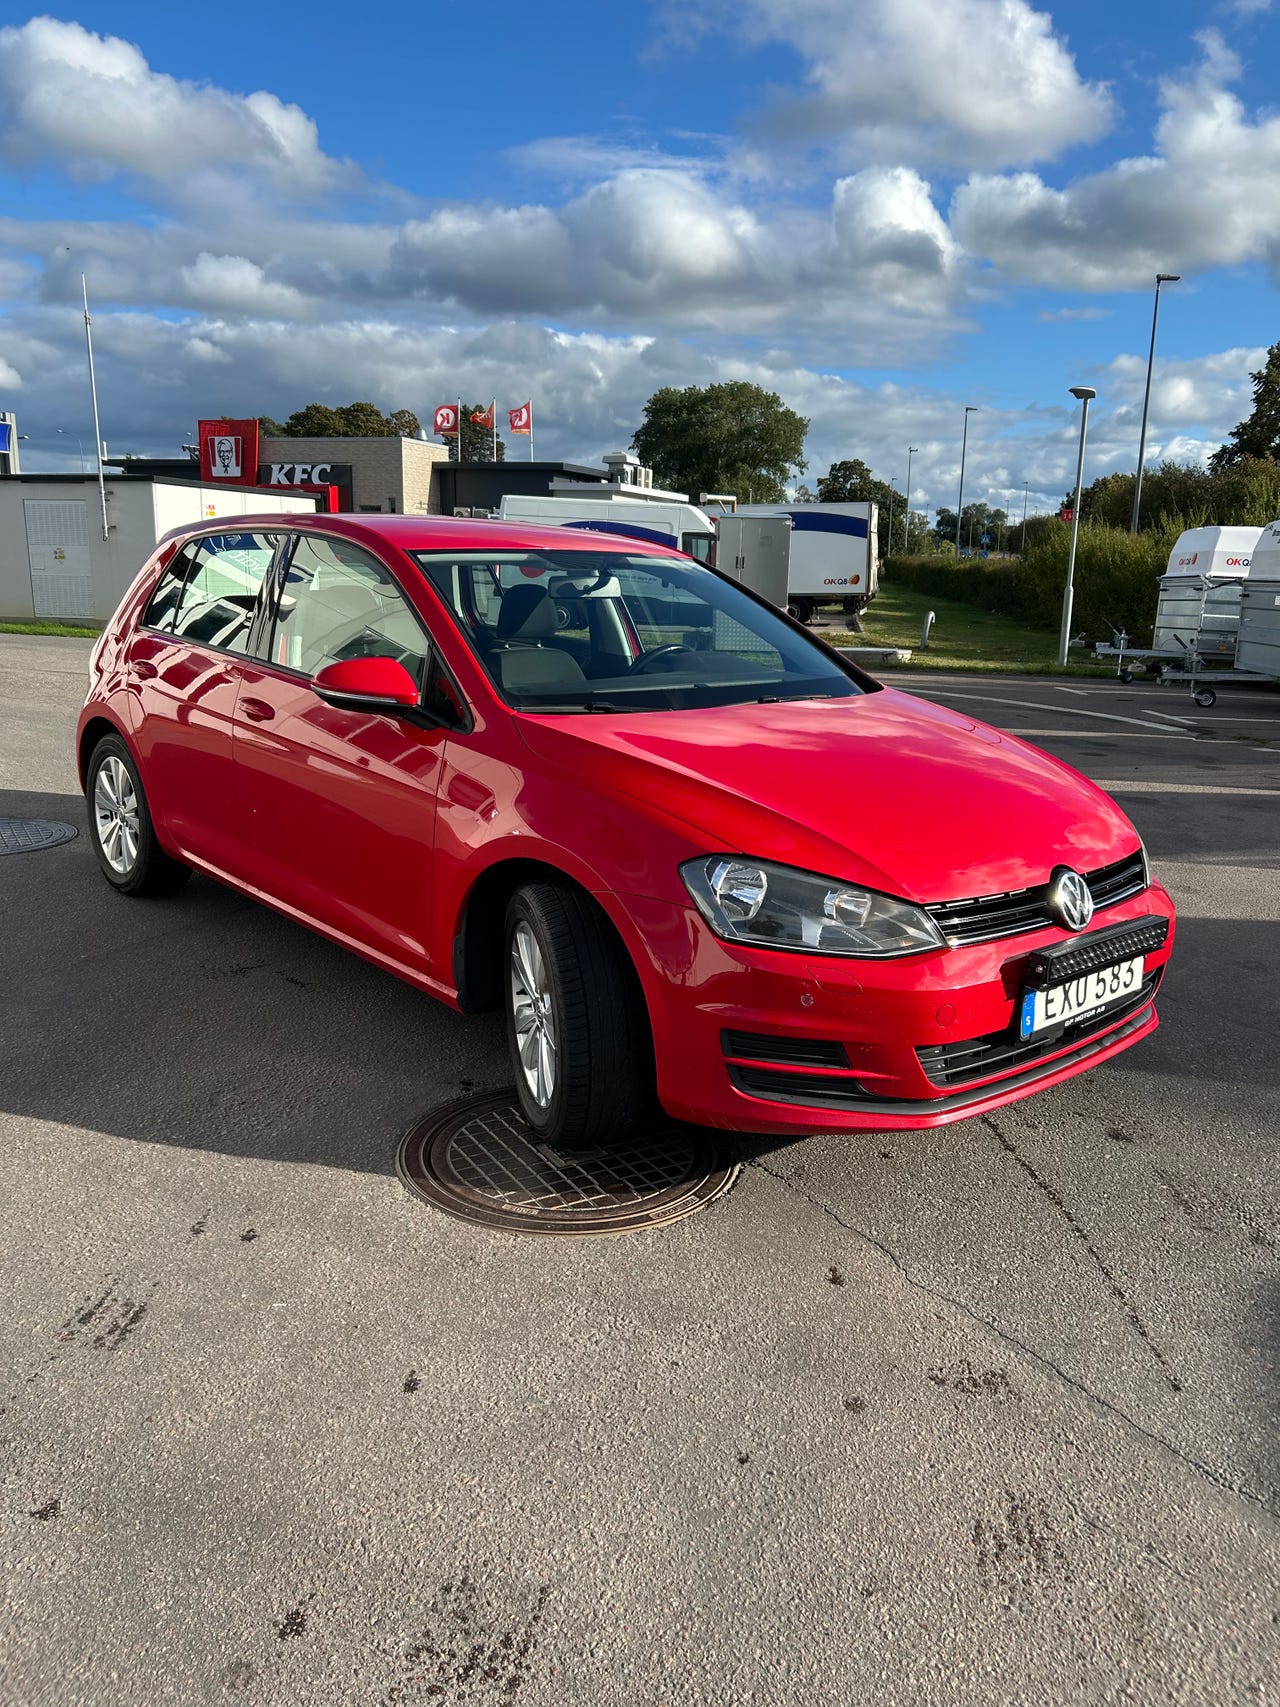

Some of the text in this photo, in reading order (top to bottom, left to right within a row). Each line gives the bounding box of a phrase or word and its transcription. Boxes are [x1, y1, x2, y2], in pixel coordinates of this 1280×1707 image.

[270, 463, 331, 485] KFC
[1226, 557, 1251, 567] OKQ
[1044, 959, 1135, 1020] EXU 583
[1025, 1015, 1031, 1026] S
[1074, 1009, 1096, 1023] MOTOR
[1096, 1005, 1106, 1014] AB
